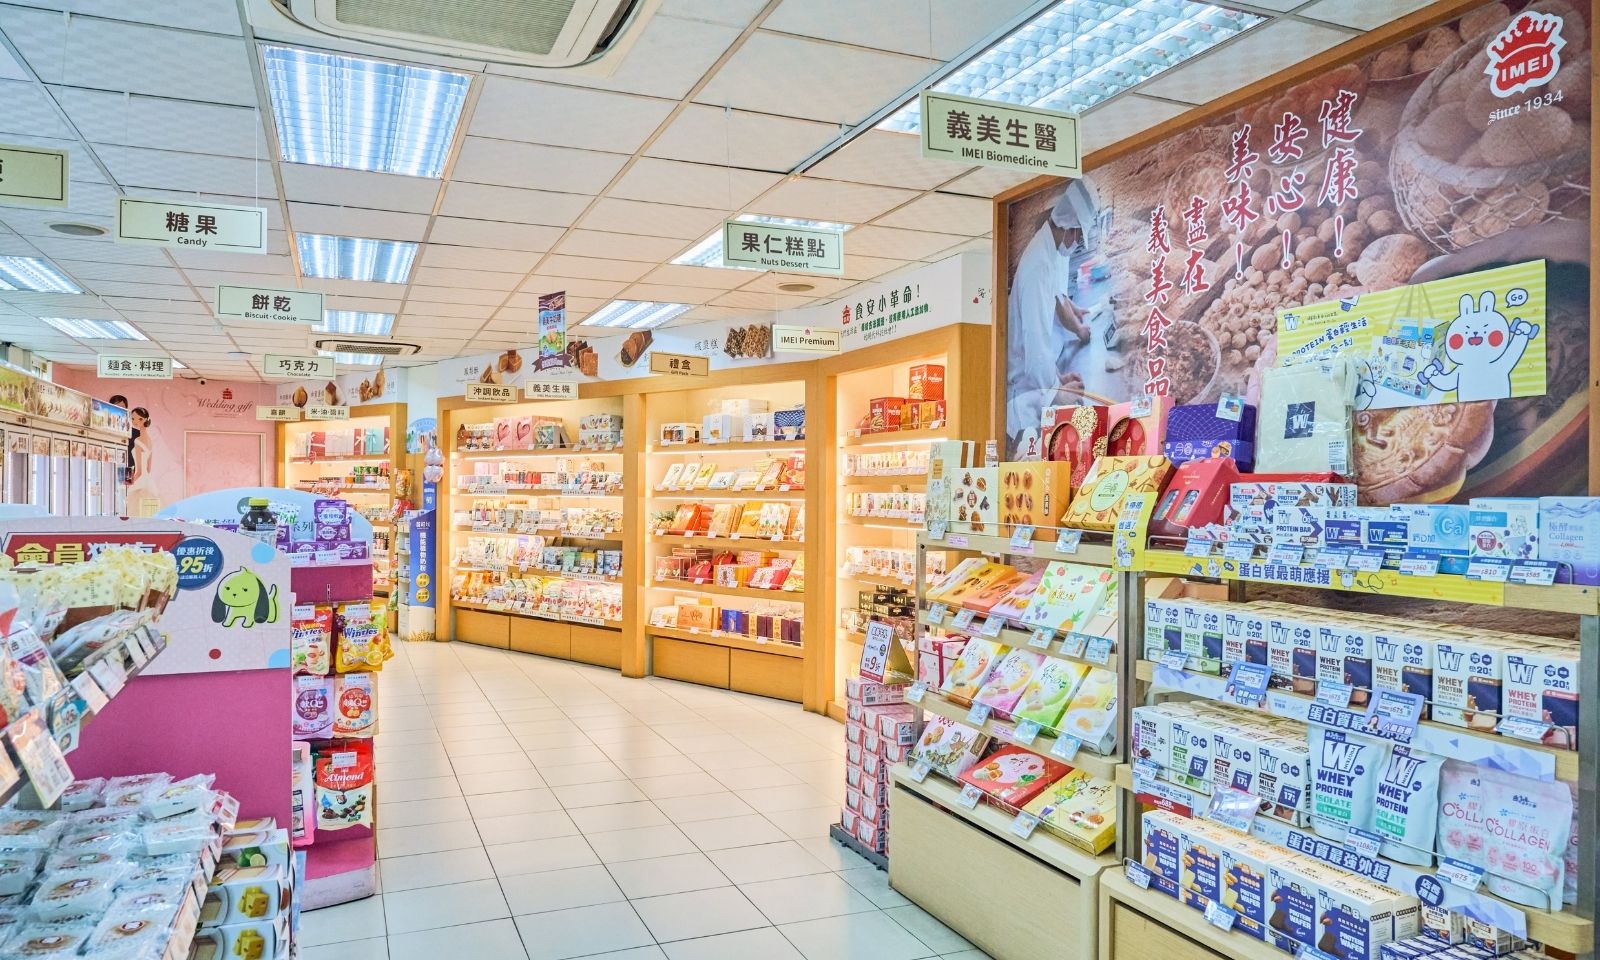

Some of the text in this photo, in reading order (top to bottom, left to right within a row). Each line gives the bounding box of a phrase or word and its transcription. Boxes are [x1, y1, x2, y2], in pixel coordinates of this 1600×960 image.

[1501, 54, 1548, 82] IMEI
[1524, 90, 1563, 112] 1934
[946, 109, 1057, 152] 義美生醫
[961, 147, 1049, 168] IMEI Biomedicine
[166, 211, 218, 236] 糖果
[177, 235, 208, 248] Candy
[741, 232, 826, 258] 果仁糕點
[1180, 196, 1210, 296] 盡在
[760, 257, 809, 269] Nuts Dessert
[252, 294, 291, 312] 餅乾
[1140, 204, 1173, 398] 義美食品
[780, 336, 835, 347] IMEI Premium
[280, 360, 319, 372] 巧克力
[669, 358, 691, 371] 禮盒
[473, 386, 510, 397] 沖調飲品
[533, 384, 570, 394] 義美生機
[197, 399, 253, 413] Wedding gift
[1276, 525, 1298, 533] PROTEIN
[1441, 518, 1463, 535] Ca
[1549, 532, 1584, 542] Collagen
[176, 547, 215, 556] 優惠折後
[1239, 563, 1331, 585] 蛋白質最萌應援
[1225, 640, 1243, 649] WHEY
[1271, 648, 1290, 657] WHEY
[1271, 655, 1290, 664] PROTEIN
[1319, 656, 1341, 667] WHEY
[1320, 664, 1341, 672] PROTEIN
[1376, 666, 1399, 676] WHEY
[1376, 674, 1399, 683] PROTEIN
[1438, 676, 1464, 688] WHEY
[1438, 685, 1463, 694] PROTEIN
[1508, 689, 1537, 701] WHEY
[1508, 698, 1537, 708] PROTEIN
[1141, 719, 1157, 730] WHEY
[1214, 763, 1229, 773] MILK
[324, 771, 364, 783] Almond
[1259, 778, 1275, 789] MILK
[1317, 769, 1355, 787] WHEY
[1315, 783, 1353, 799] PROTEIN
[1378, 782, 1412, 803] WHEY
[1315, 793, 1352, 809] ISOLATE
[1376, 796, 1408, 815] PROTEIN
[1486, 817, 1551, 851] COLLAGEN
[1288, 831, 1390, 882] 蛋白質最強外援
[1197, 876, 1216, 888] WAFER
[1240, 894, 1261, 908] WAFER
[1289, 908, 1312, 923] PROTEIN
[1289, 915, 1312, 930] WAFER
[1339, 931, 1365, 947] PROTEIN
[1340, 939, 1365, 954] WAFER
